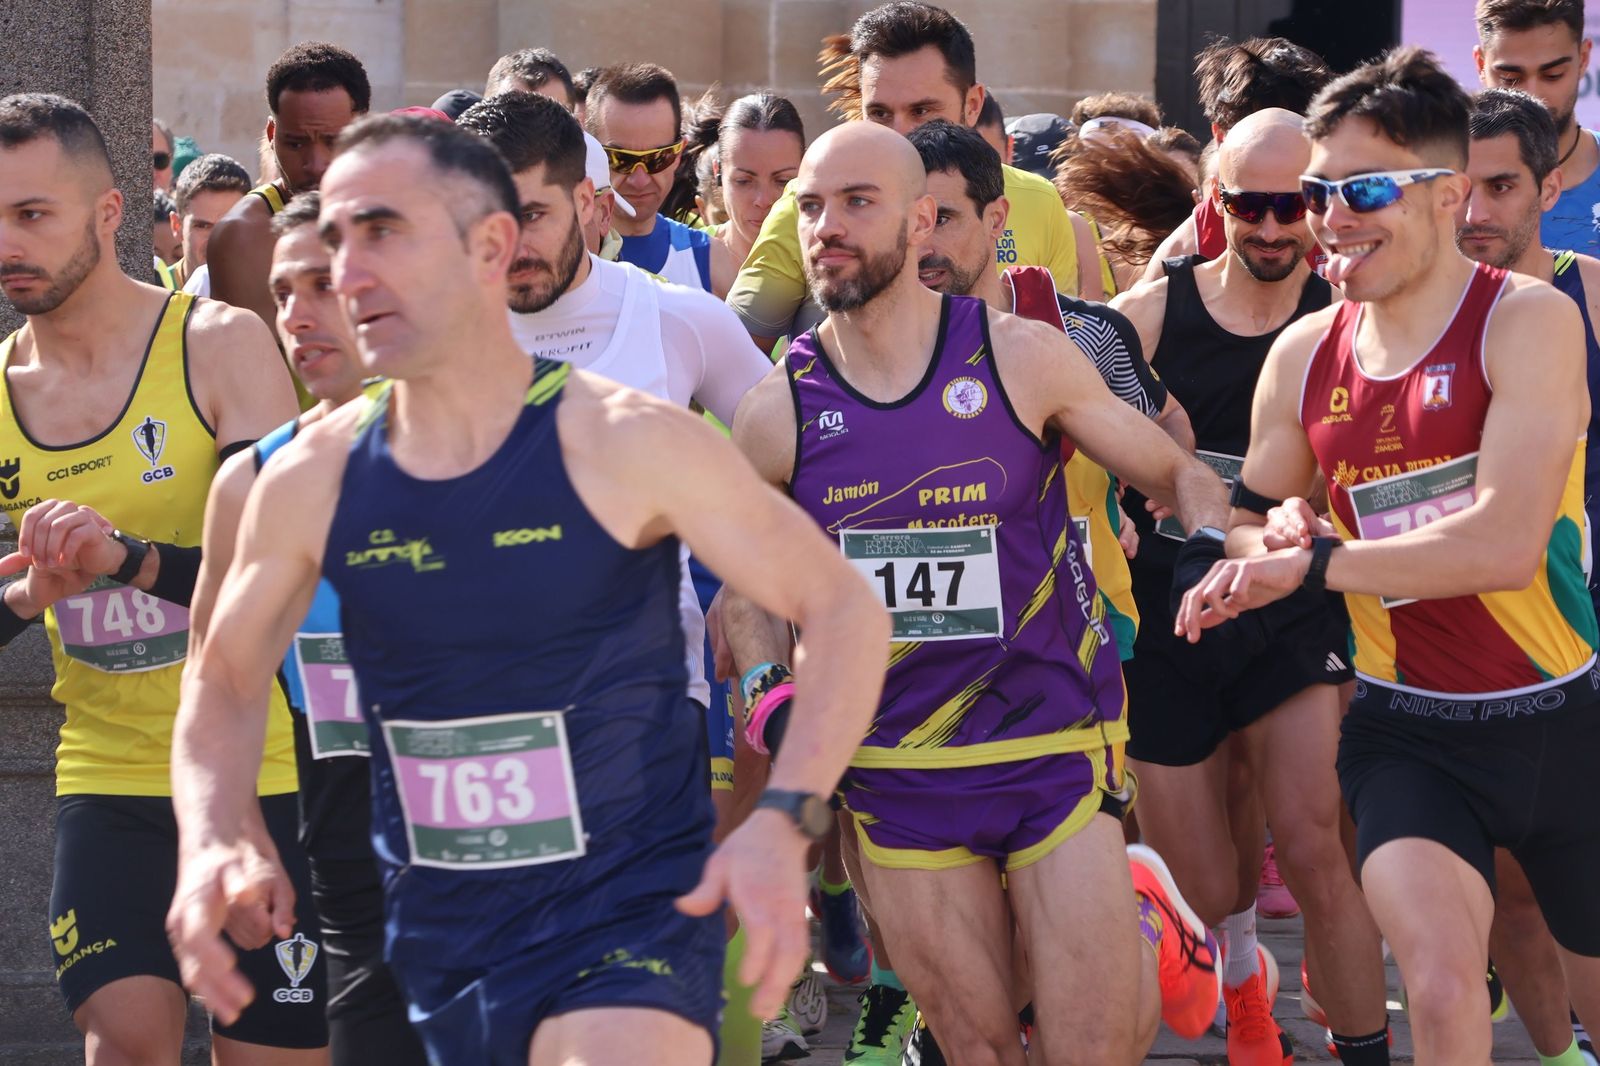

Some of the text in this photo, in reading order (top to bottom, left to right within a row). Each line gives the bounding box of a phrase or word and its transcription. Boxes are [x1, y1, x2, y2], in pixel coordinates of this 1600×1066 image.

[47, 455, 113, 482] CCI SPORT
[142, 466, 174, 483] GCB
[822, 479, 987, 507] Jamón PRIM
[907, 512, 998, 529] Macotera
[874, 560, 965, 609] 147
[67, 588, 166, 643] 748
[1389, 687, 1567, 722] NIKE PRO
[417, 757, 536, 824] 763
[276, 989, 311, 1002] GCB
